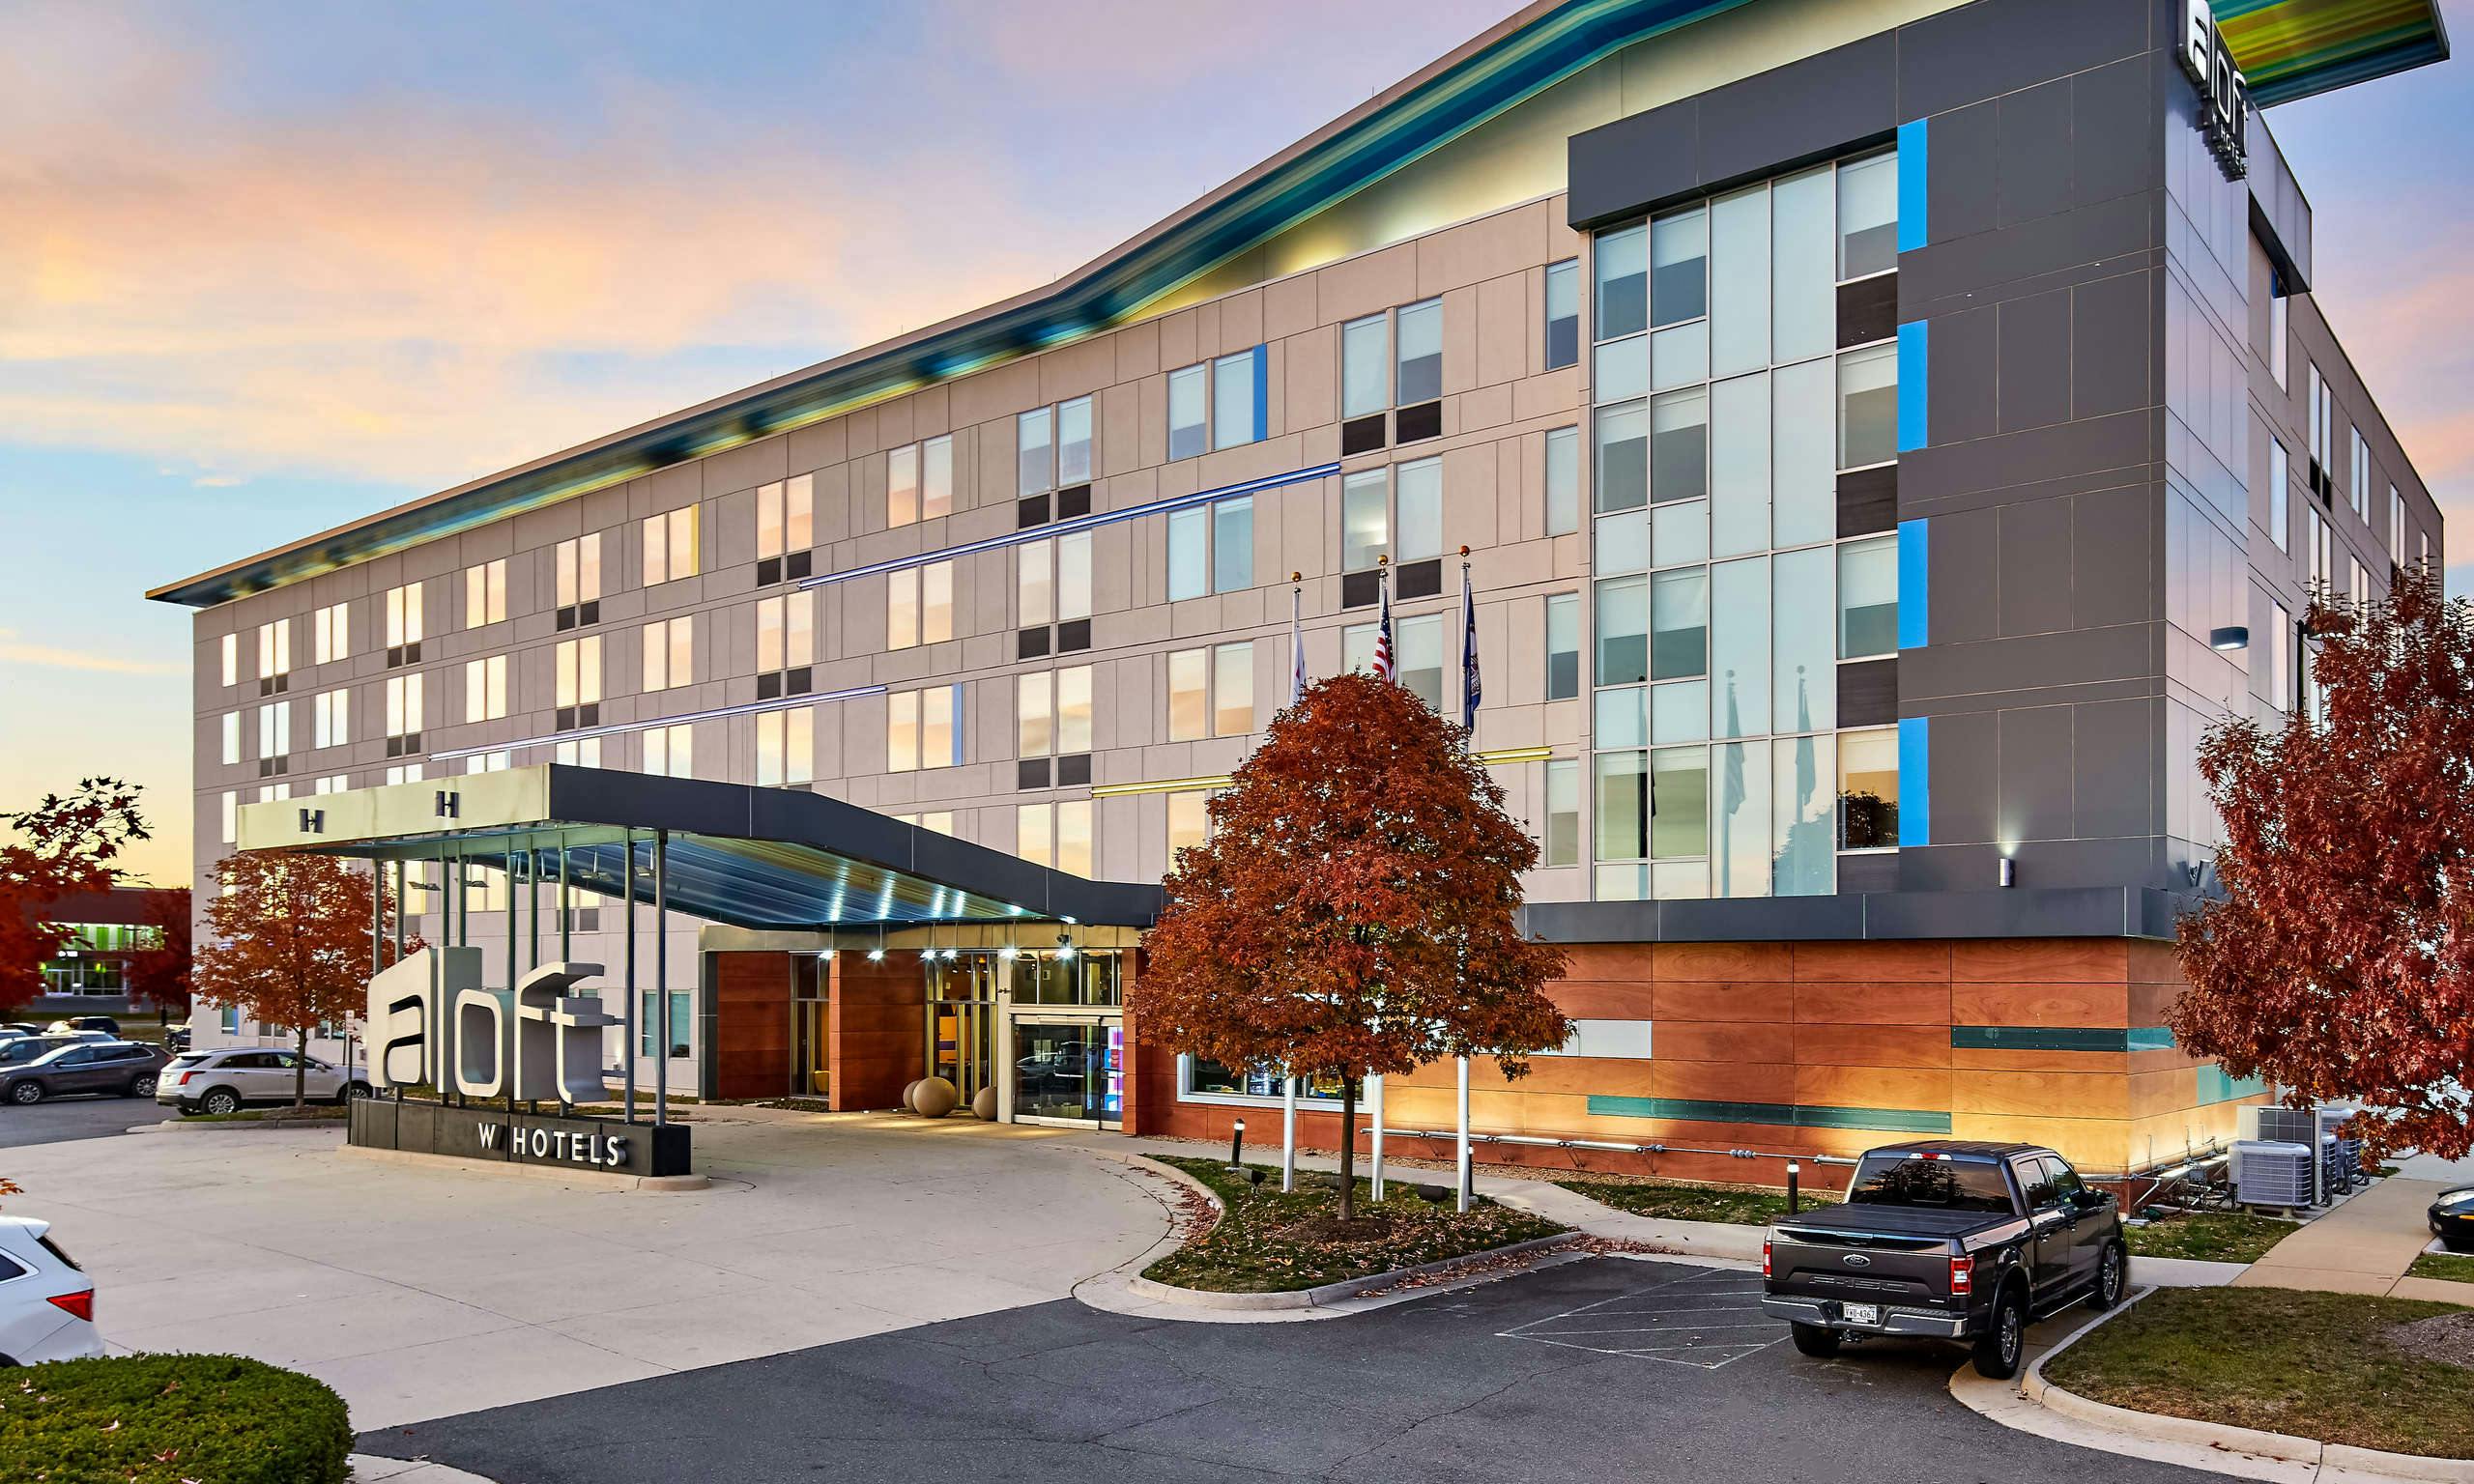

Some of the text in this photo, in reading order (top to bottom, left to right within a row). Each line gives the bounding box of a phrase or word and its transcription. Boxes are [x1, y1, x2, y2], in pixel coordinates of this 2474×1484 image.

[2188, 0, 2248, 157] aloft
[367, 946, 601, 1105] aloft
[478, 1122, 623, 1166] W HOTELS
